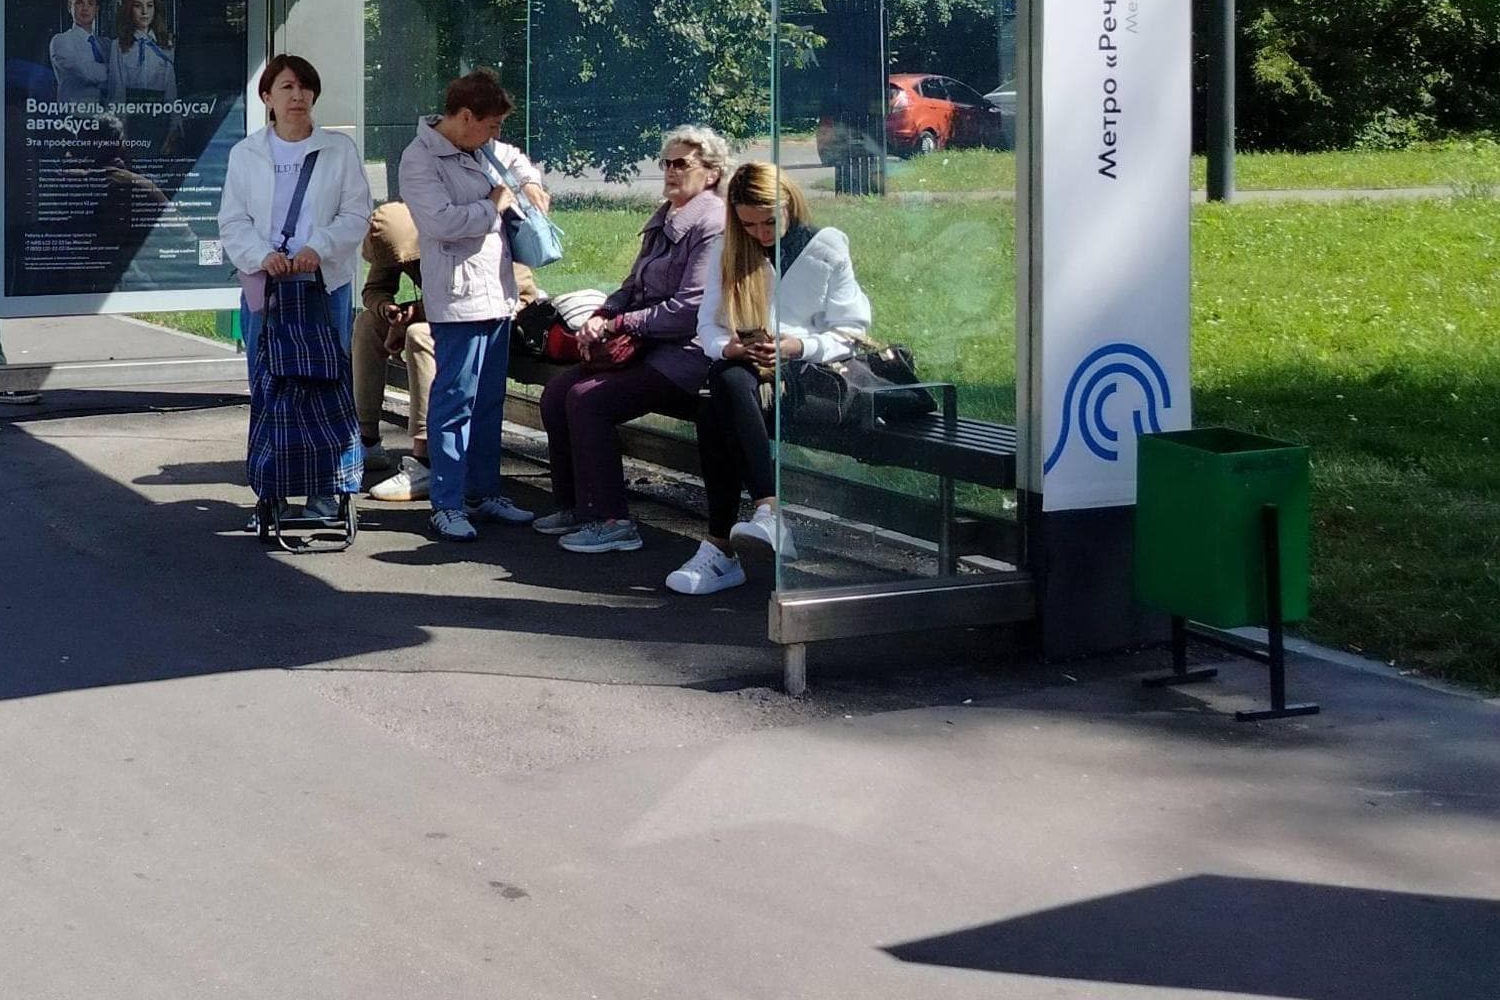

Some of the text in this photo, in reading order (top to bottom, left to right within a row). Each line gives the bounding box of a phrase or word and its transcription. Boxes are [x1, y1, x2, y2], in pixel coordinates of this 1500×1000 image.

[26, 98, 217, 117] Водитель электробуса/
[26, 117, 100, 134] автобуса
[1097, 77, 1121, 179] Метро
[26, 138, 151, 149] Эта профессия нужна городу
